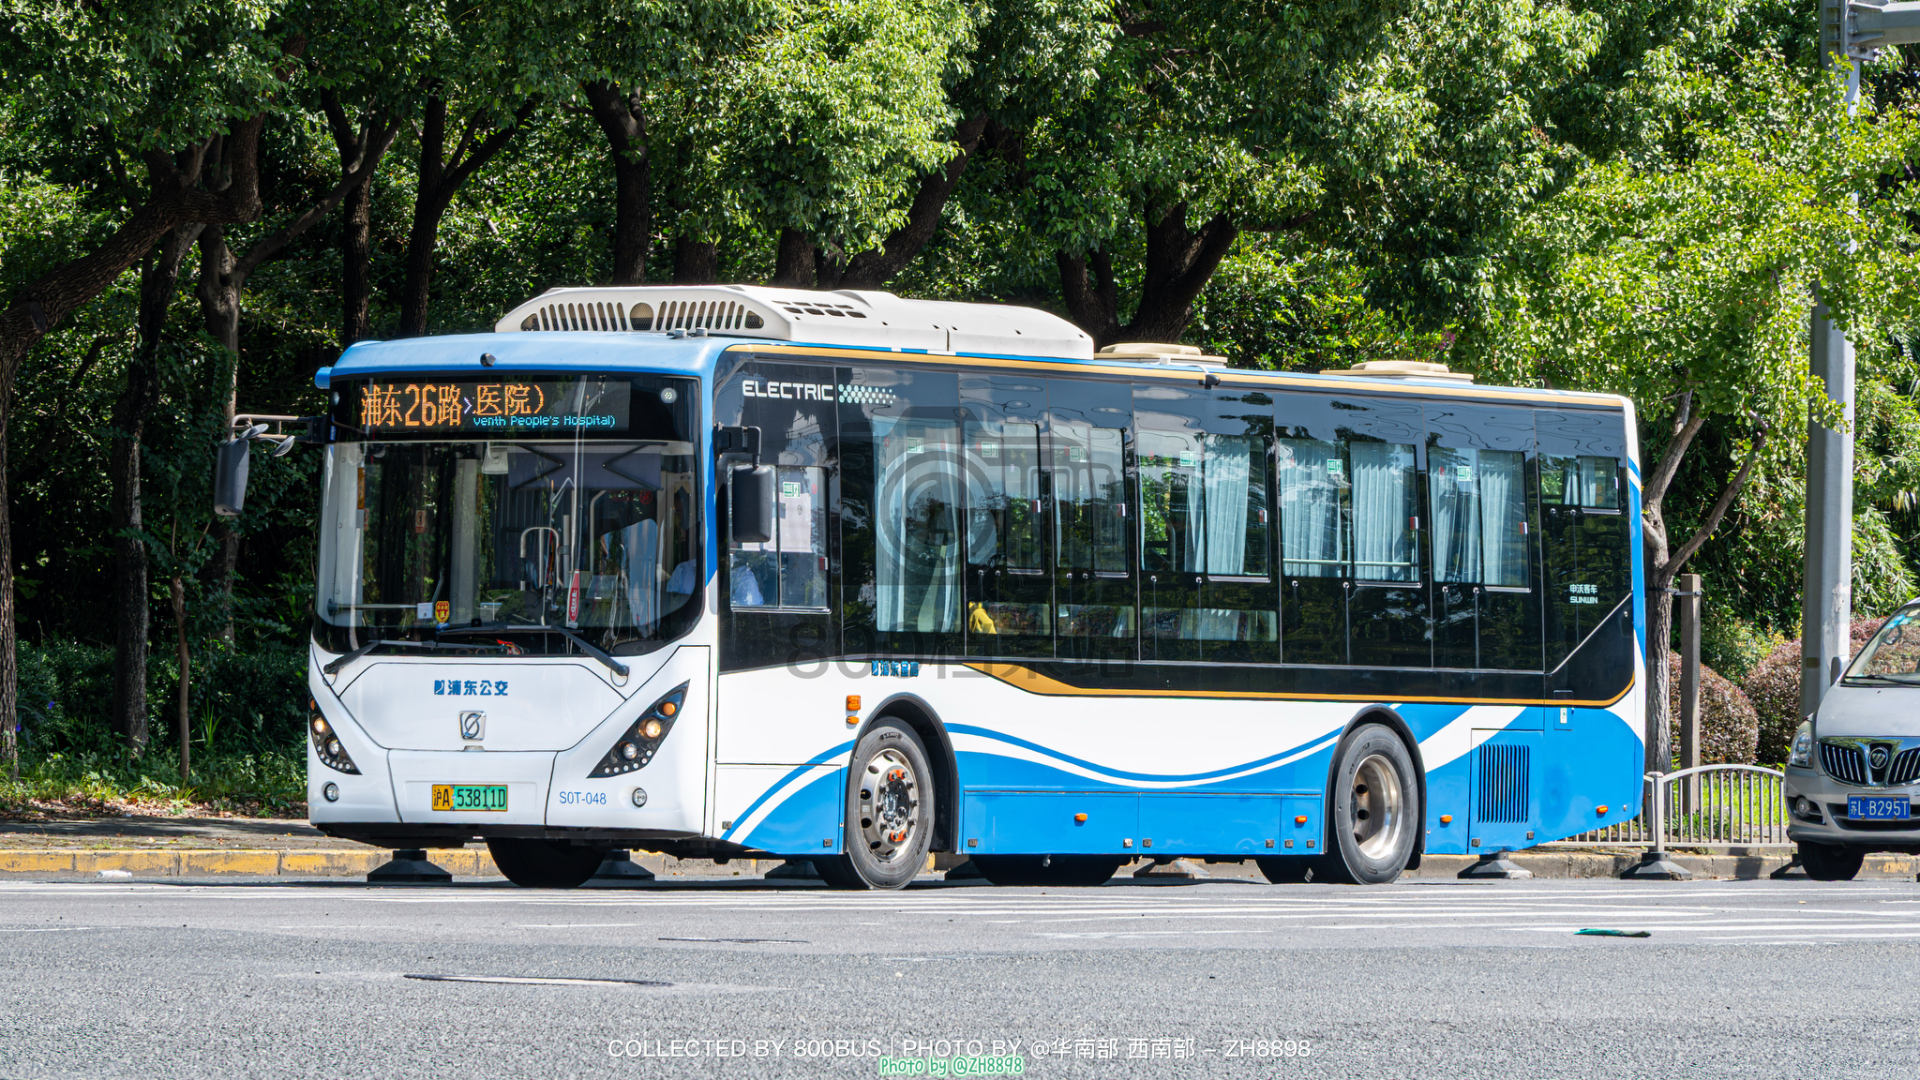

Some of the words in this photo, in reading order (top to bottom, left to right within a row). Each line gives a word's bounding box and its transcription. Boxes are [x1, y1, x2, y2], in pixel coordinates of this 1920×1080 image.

[742, 380, 834, 401] ELECTRIC
[361, 384, 462, 426] 浦东26路
[510, 415, 559, 428] People's
[563, 415, 615, 428] Hospital)
[1569, 584, 1598, 594] 申沃客车
[1569, 595, 1598, 604] SUNWIN
[447, 680, 508, 696] 浦东公交
